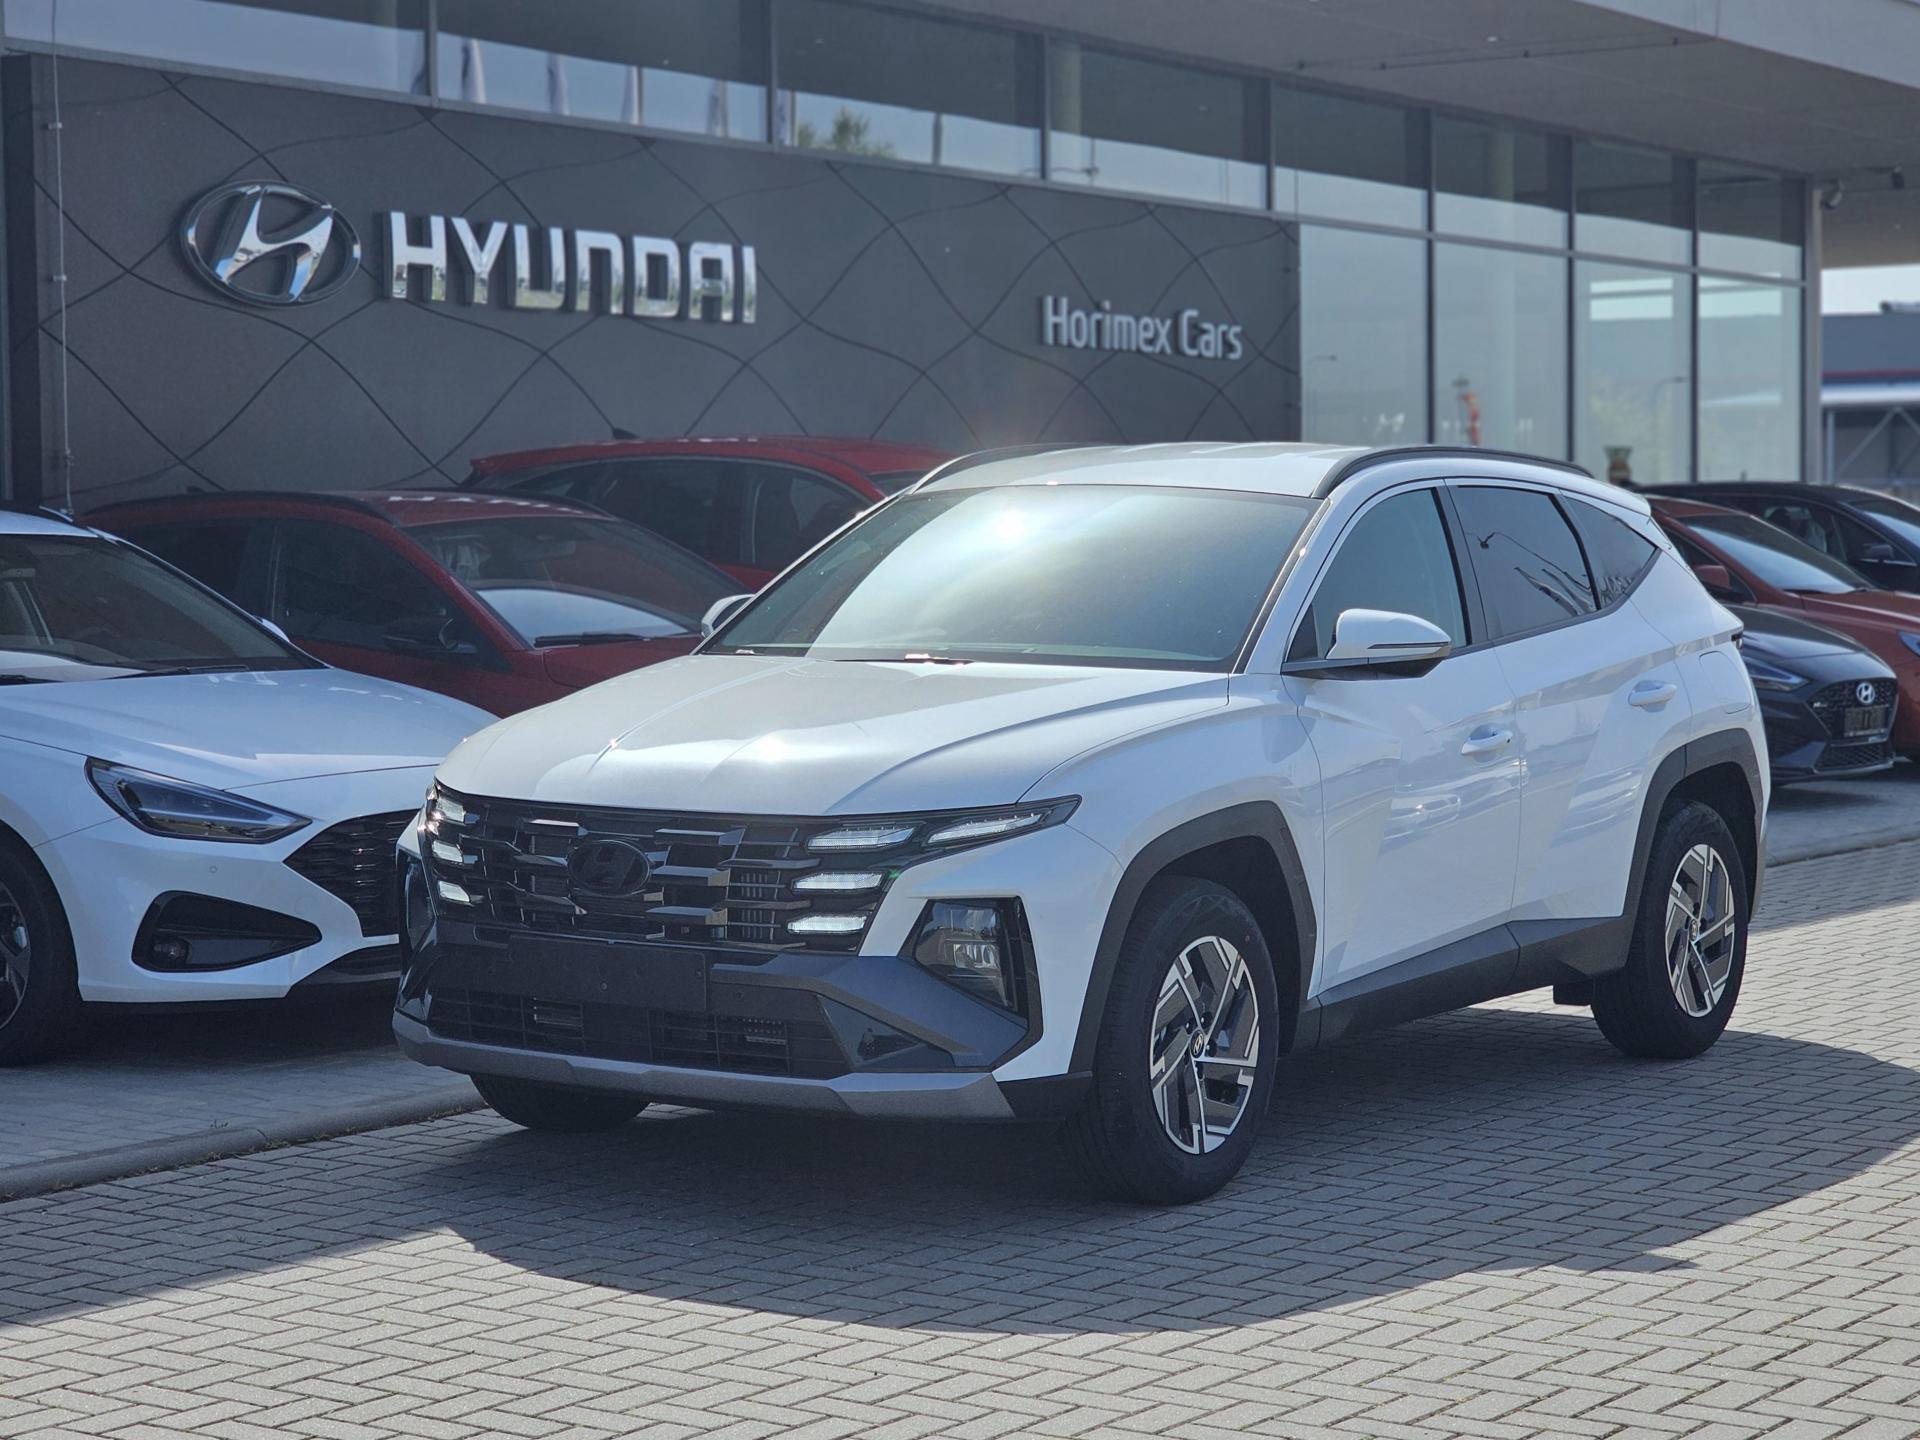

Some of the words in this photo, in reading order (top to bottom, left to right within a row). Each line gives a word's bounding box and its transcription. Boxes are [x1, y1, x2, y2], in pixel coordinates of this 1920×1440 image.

[388, 211, 757, 324] HYUNDAI
[1044, 295, 1172, 354] Horimex
[1180, 309, 1243, 360] Cars
